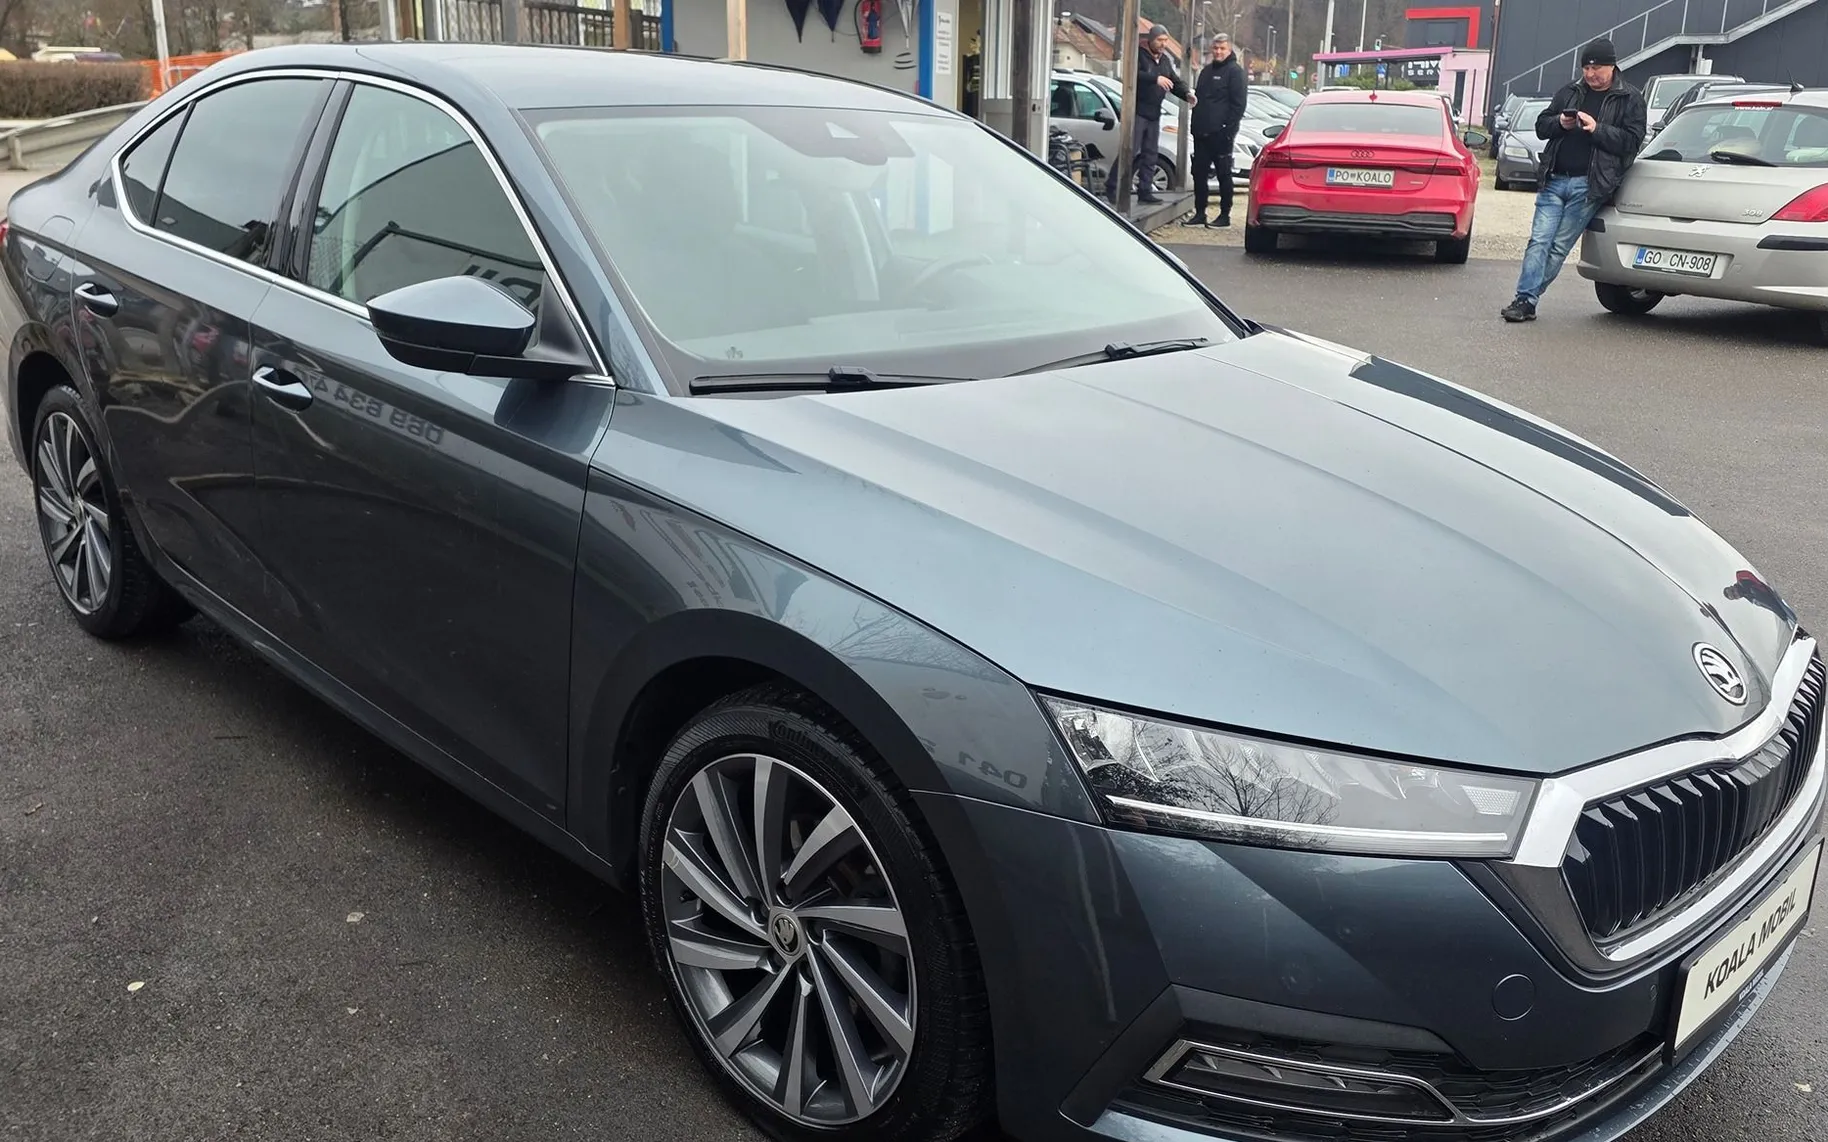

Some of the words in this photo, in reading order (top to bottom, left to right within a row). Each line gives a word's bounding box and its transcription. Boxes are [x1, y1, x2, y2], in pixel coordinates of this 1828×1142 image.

[1335, 170, 1350, 181] PO
[1644, 250, 1662, 264] GO
[1669, 254, 1712, 271] CN-908
[1704, 932, 1755, 1000] KOALA
[1757, 888, 1797, 949] MOBIL
